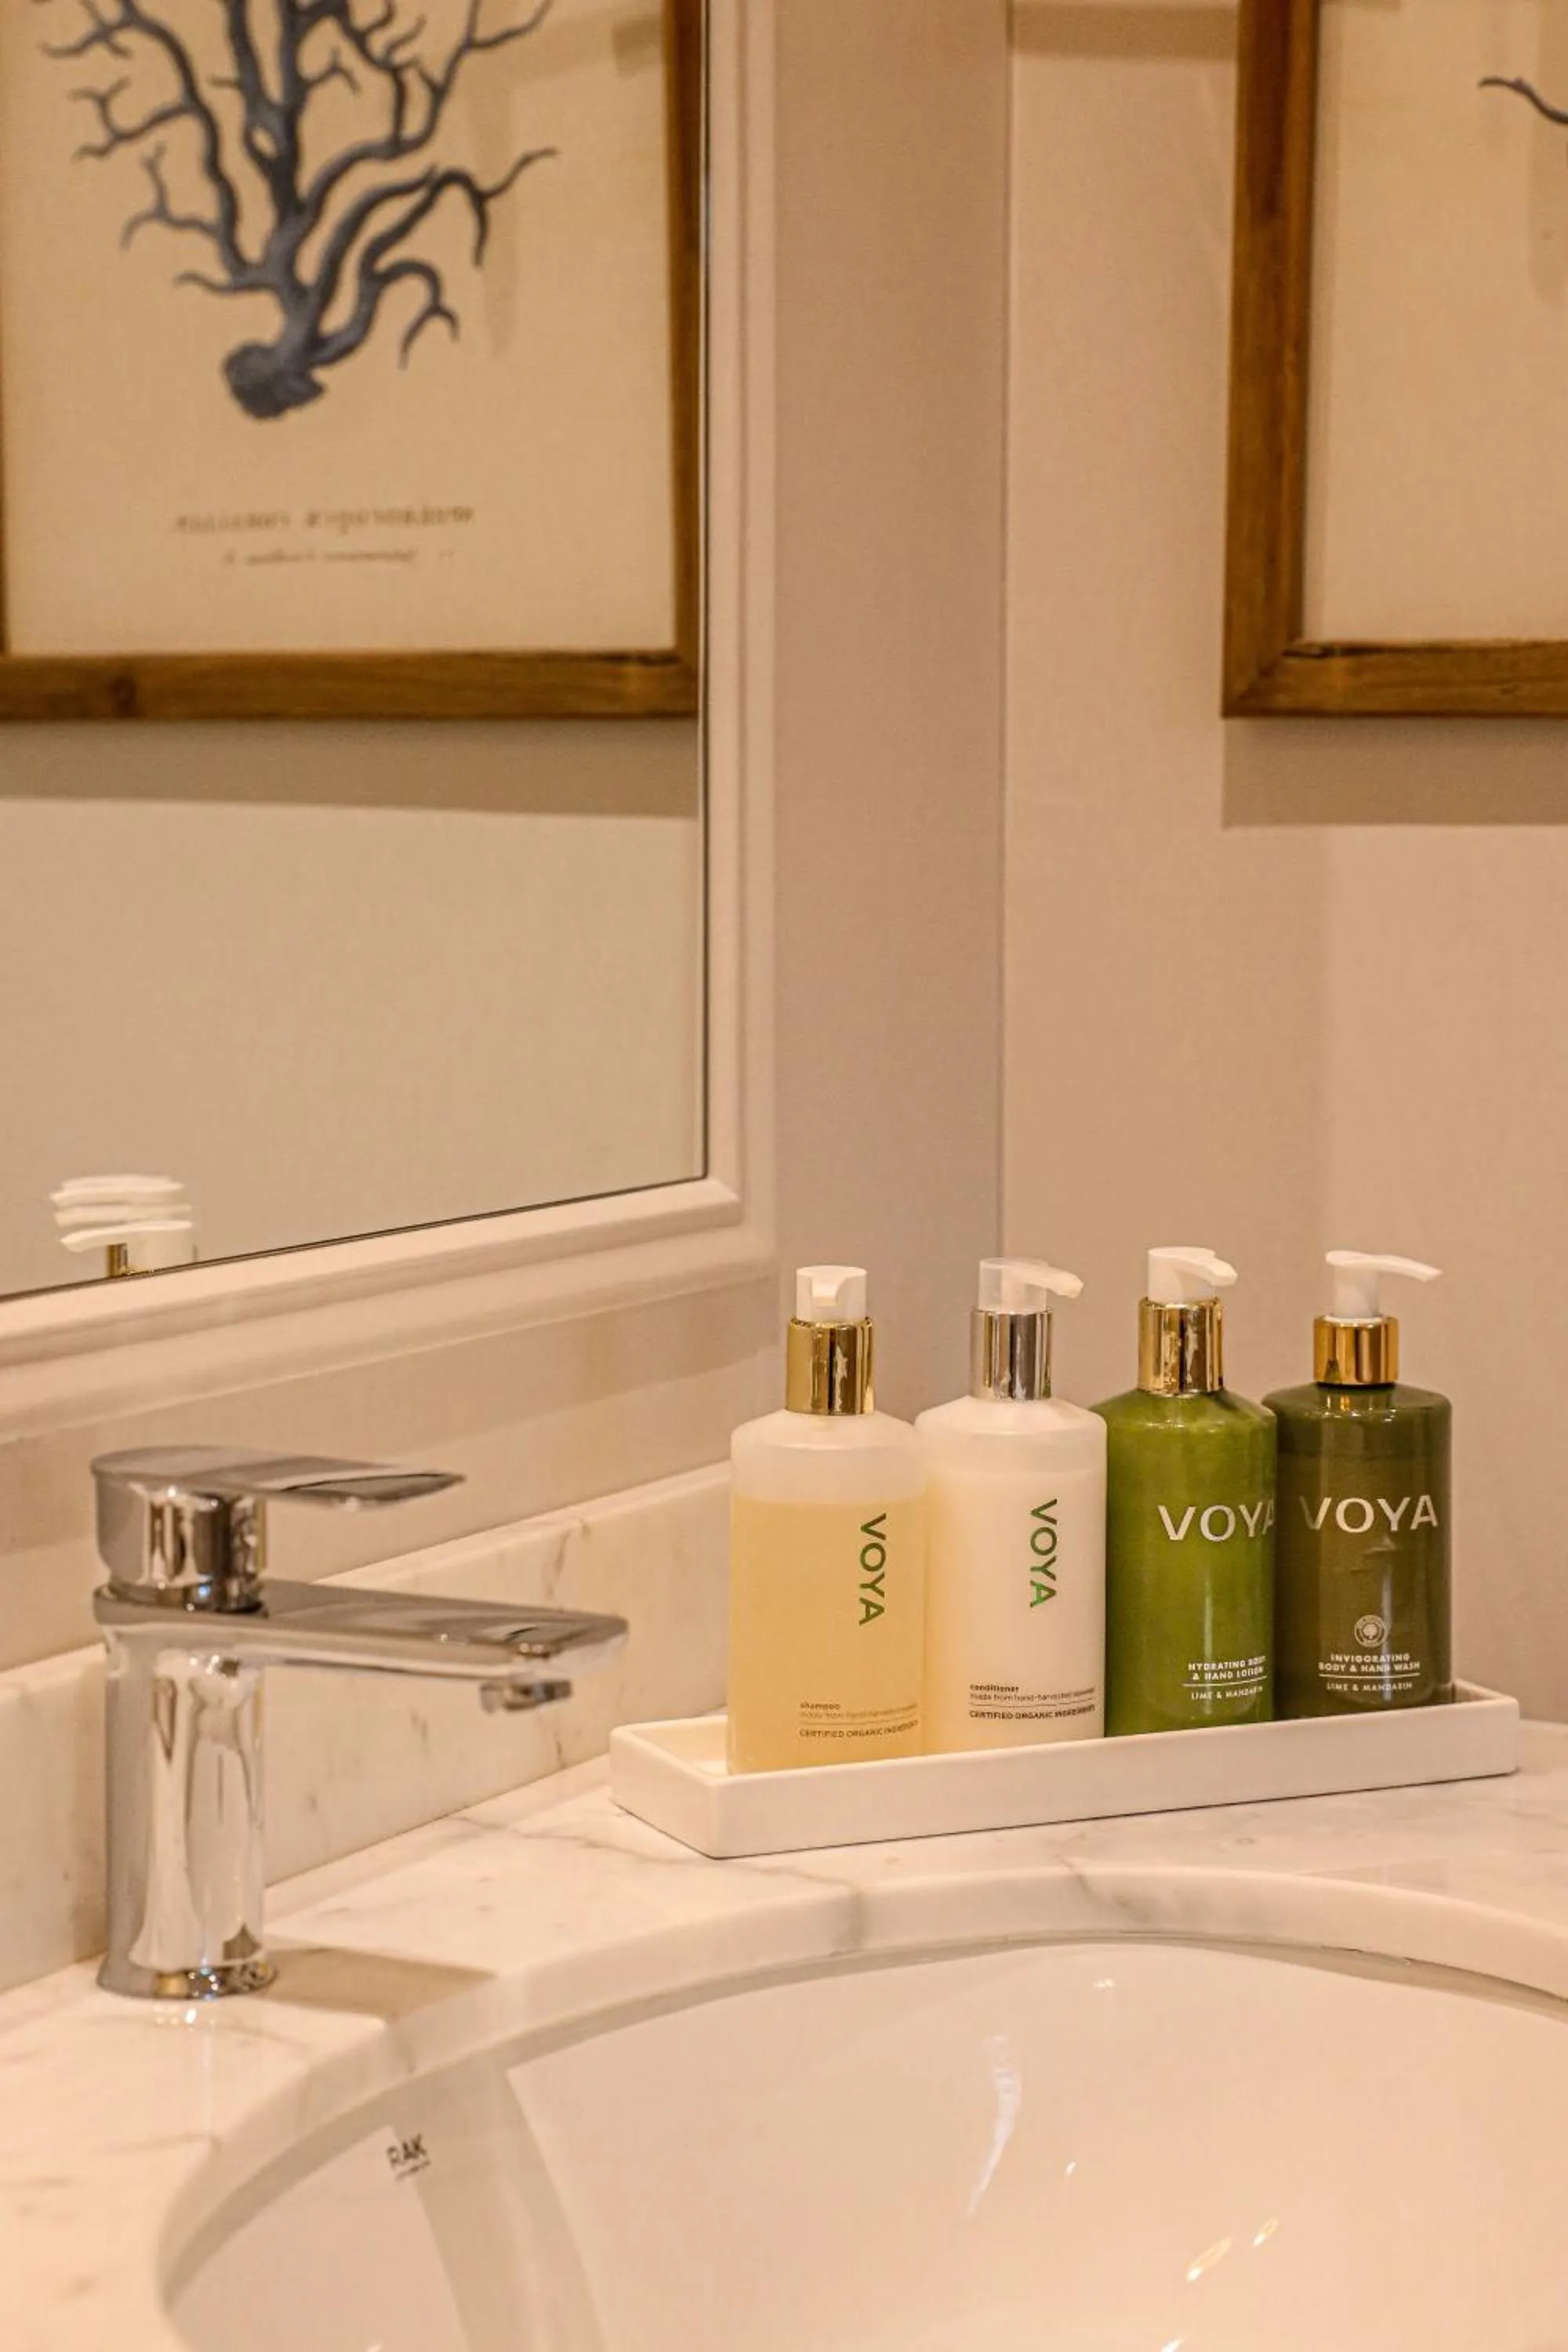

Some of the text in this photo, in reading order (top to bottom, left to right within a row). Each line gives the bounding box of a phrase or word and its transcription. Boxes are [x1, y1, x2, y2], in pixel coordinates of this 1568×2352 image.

[1157, 1497, 1275, 1541] VOYA
[1298, 1494, 1439, 1533] VOYA
[1029, 1497, 1057, 1607] VOYA
[858, 1512, 887, 1626] VOYA
[1330, 1653, 1410, 1663] INVIGORATING
[1188, 1660, 1246, 1671] HYDRATING
[1318, 1661, 1421, 1672] BODY & HAND WASH
[1204, 1671, 1233, 1680] HAND
[970, 1684, 1019, 1693] conditioner
[1326, 1682, 1412, 1691] LIME & MANDARIN
[1191, 1691, 1213, 1700] LIME
[800, 1700, 841, 1711] shampoo
[969, 1710, 1014, 1719] CERTIFIED
[1014, 1711, 1052, 1719] ORGANIC
[799, 1728, 844, 1738] CERTIFIED
[846, 1726, 883, 1738] ORGANIC
[386, 2132, 427, 2169] RAK
